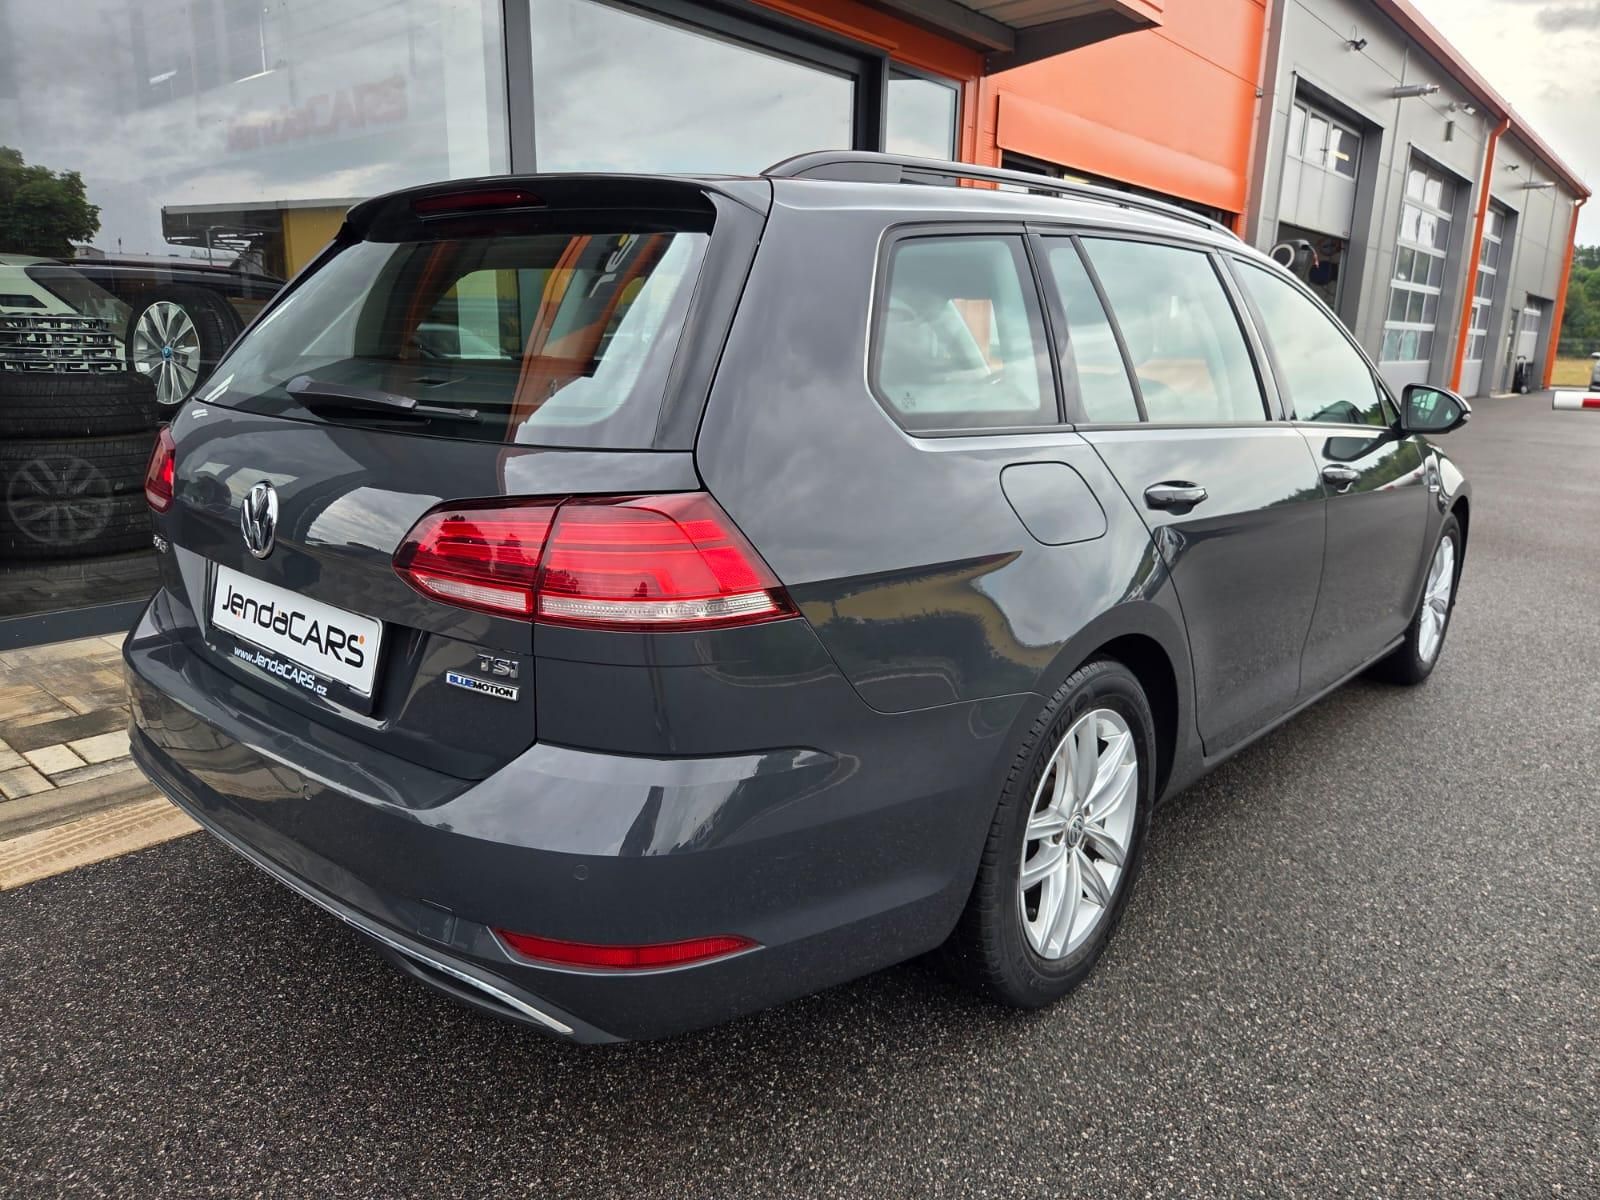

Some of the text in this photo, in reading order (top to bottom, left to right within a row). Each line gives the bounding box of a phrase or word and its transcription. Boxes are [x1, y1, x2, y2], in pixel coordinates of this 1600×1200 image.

[222, 584, 366, 669] JendaCARS
[233, 646, 328, 696] www.JendaCARS.cz
[449, 675, 514, 698] BLUEMOTION
